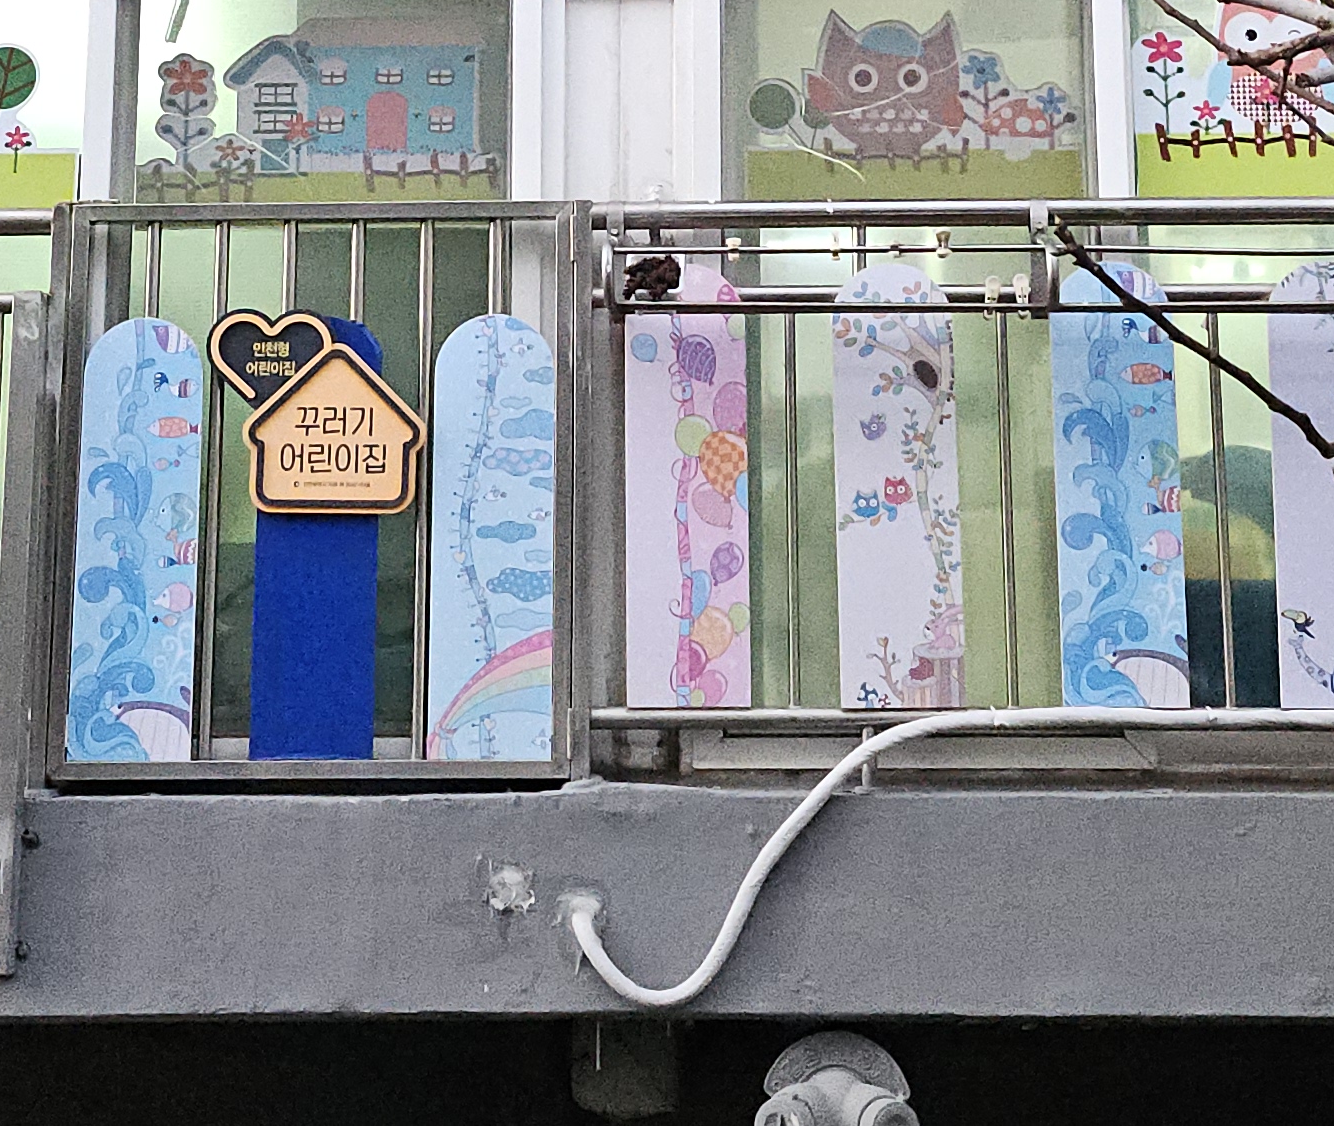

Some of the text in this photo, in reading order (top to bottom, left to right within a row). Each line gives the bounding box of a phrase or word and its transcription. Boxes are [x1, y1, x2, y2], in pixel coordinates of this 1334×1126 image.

[252, 341, 290, 358] 인천형
[245, 360, 296, 377] 어린이집
[294, 406, 375, 437] 꾸러기
[279, 442, 388, 475] 어린이집
